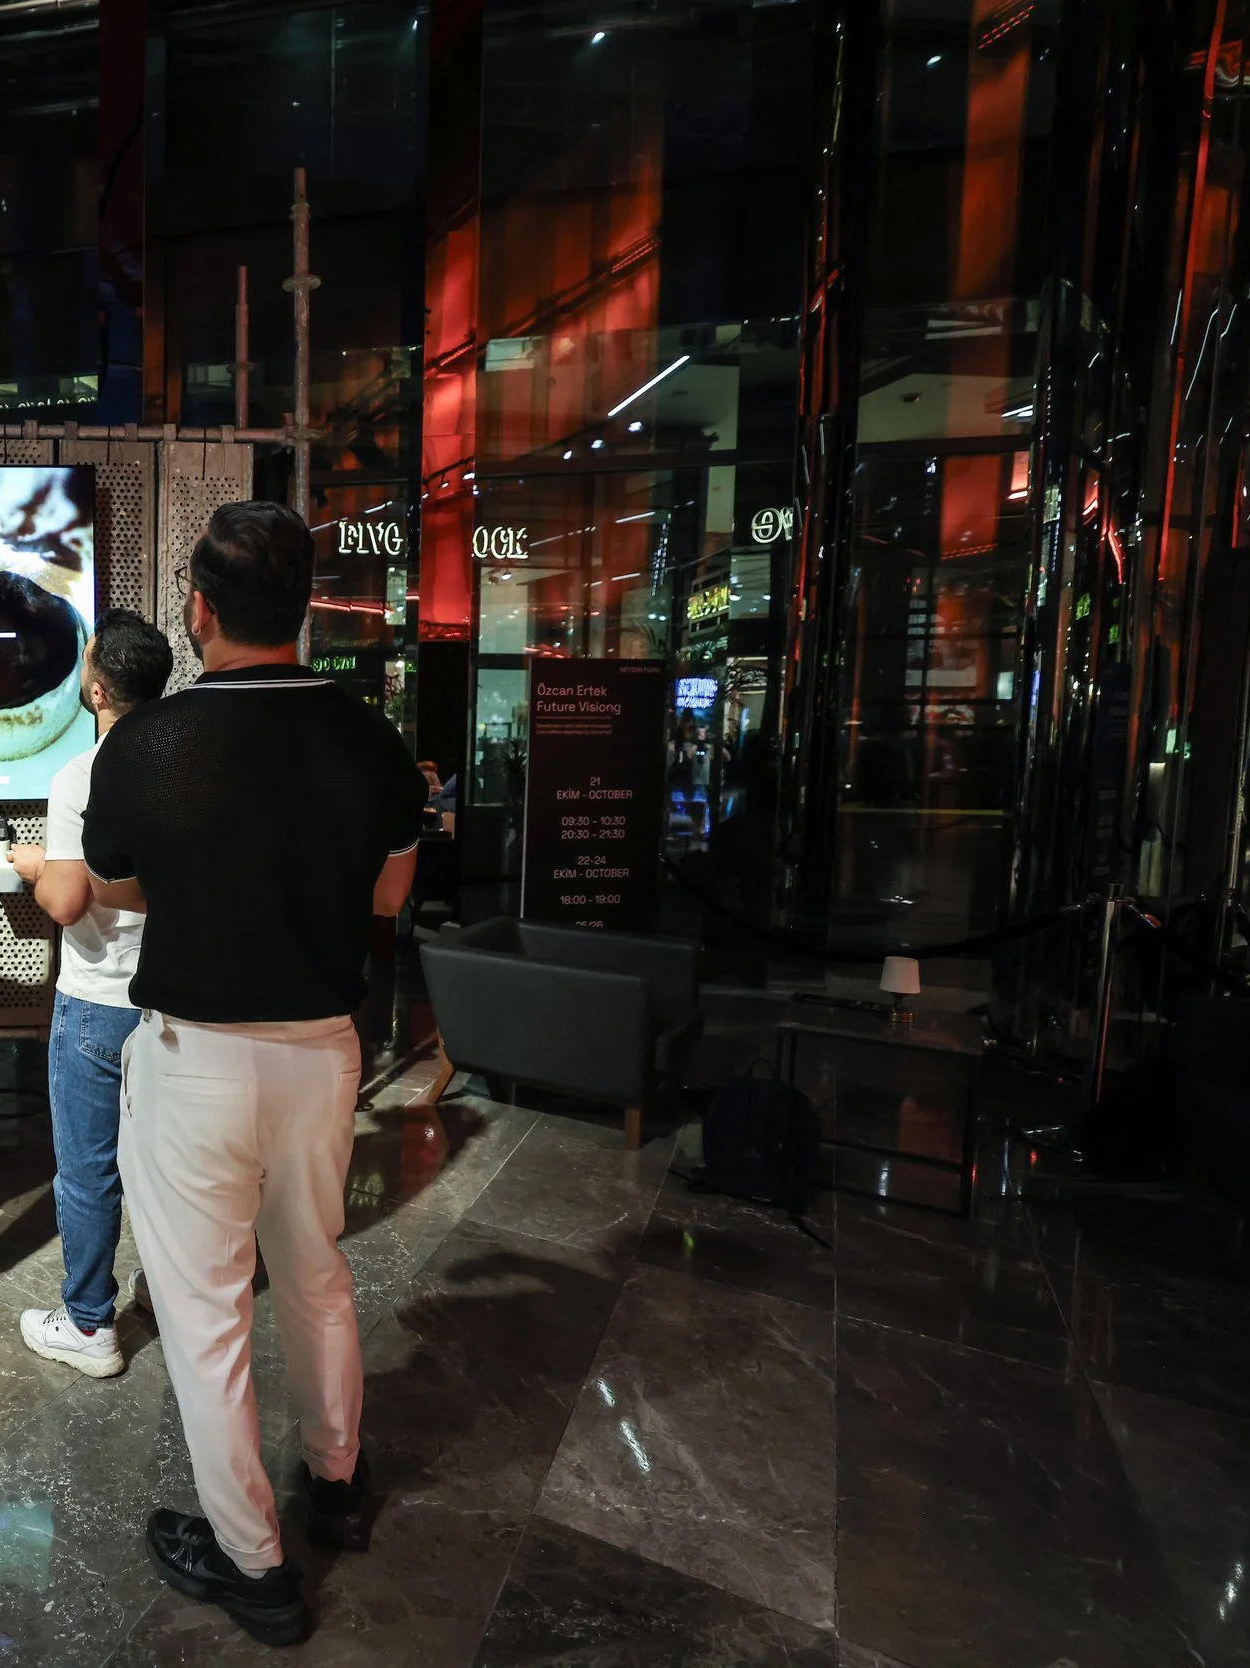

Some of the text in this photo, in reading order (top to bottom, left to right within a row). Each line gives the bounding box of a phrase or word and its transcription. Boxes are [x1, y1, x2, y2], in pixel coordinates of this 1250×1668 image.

[537, 682, 608, 697] Özcan Ertek
[536, 700, 576, 713] Future
[589, 776, 601, 787] 21
[556, 788, 580, 800] EKİM
[588, 789, 633, 800] OCTOBER
[561, 816, 590, 827] 09:30
[600, 815, 627, 826] 10:30
[560, 829, 590, 840] 20:30
[599, 829, 626, 839] 21:30
[577, 855, 607, 866] 22-24
[553, 867, 577, 879] EKİM
[585, 868, 630, 879] OCTOBER
[559, 895, 587, 905] 18:00
[595, 894, 621, 904] 19:00
